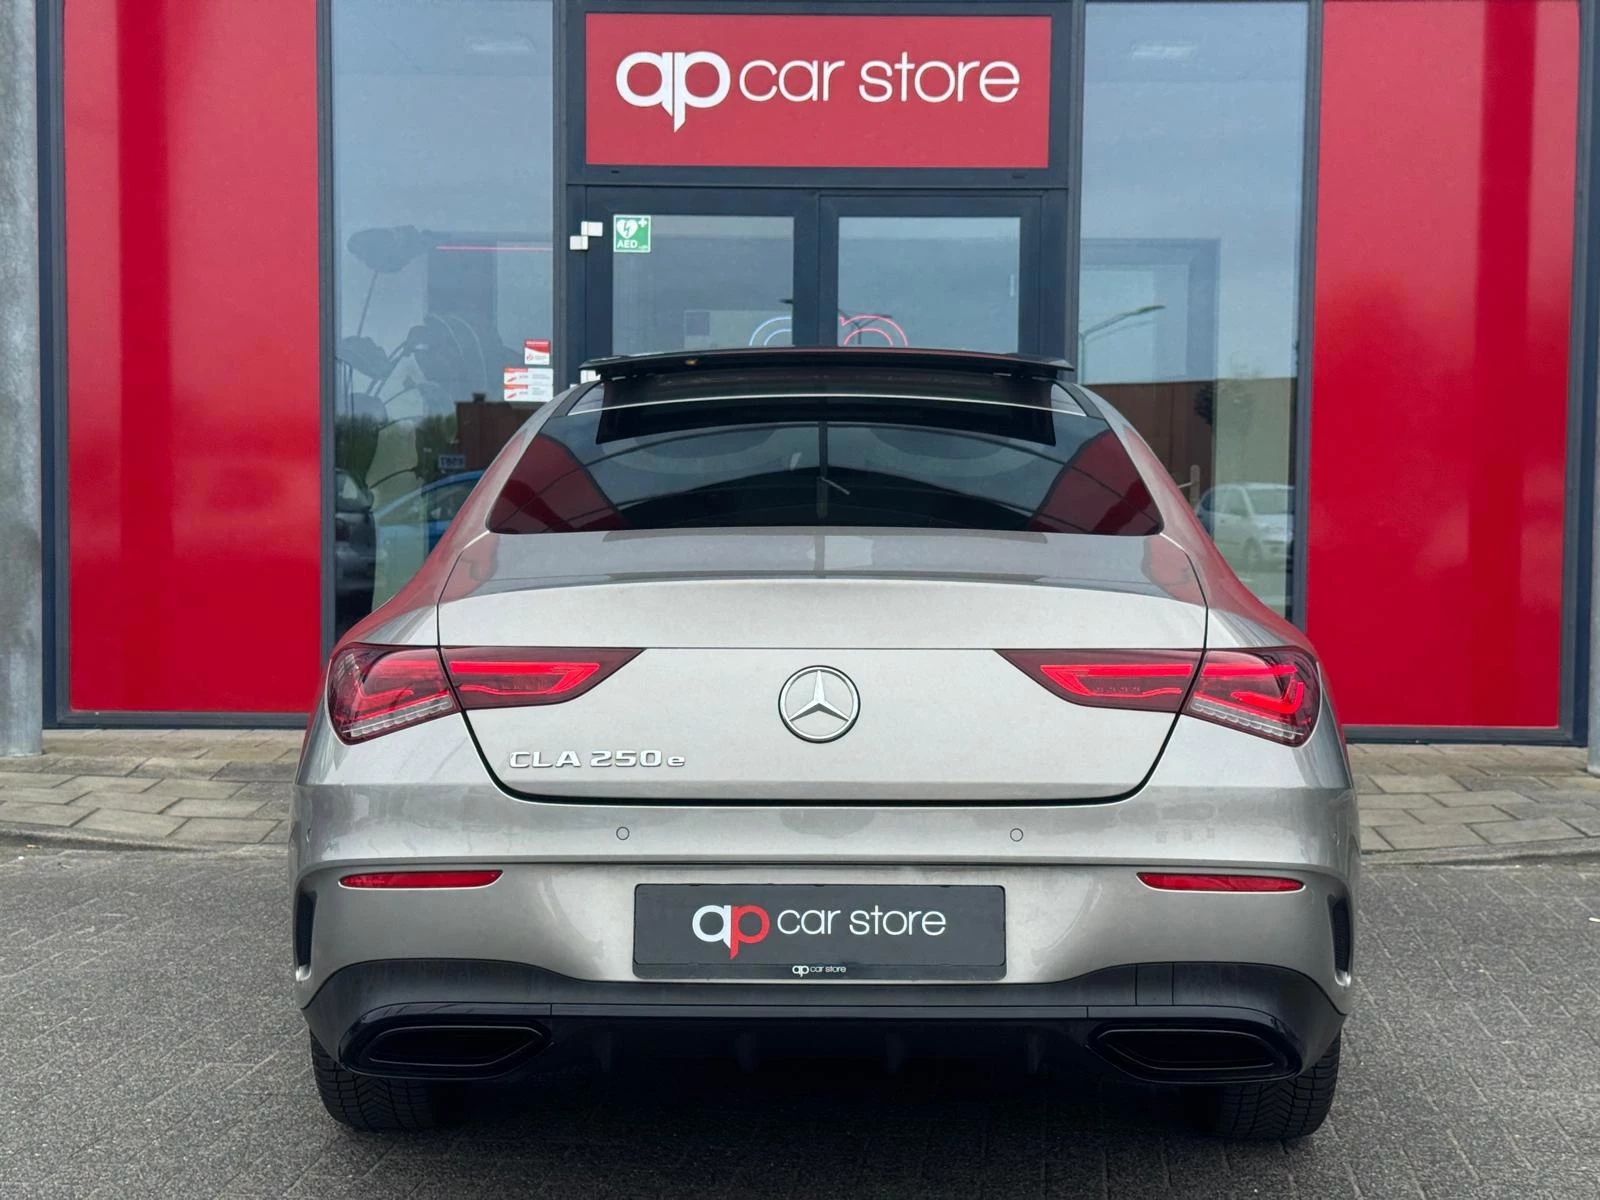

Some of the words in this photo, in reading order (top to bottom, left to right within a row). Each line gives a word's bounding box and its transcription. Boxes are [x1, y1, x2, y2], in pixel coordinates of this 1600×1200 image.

[739, 59, 845, 102] car
[859, 52, 1020, 103] store
[617, 240, 638, 249] AED
[509, 751, 582, 768] CLA
[777, 909, 841, 935] car
[849, 905, 946, 936] store
